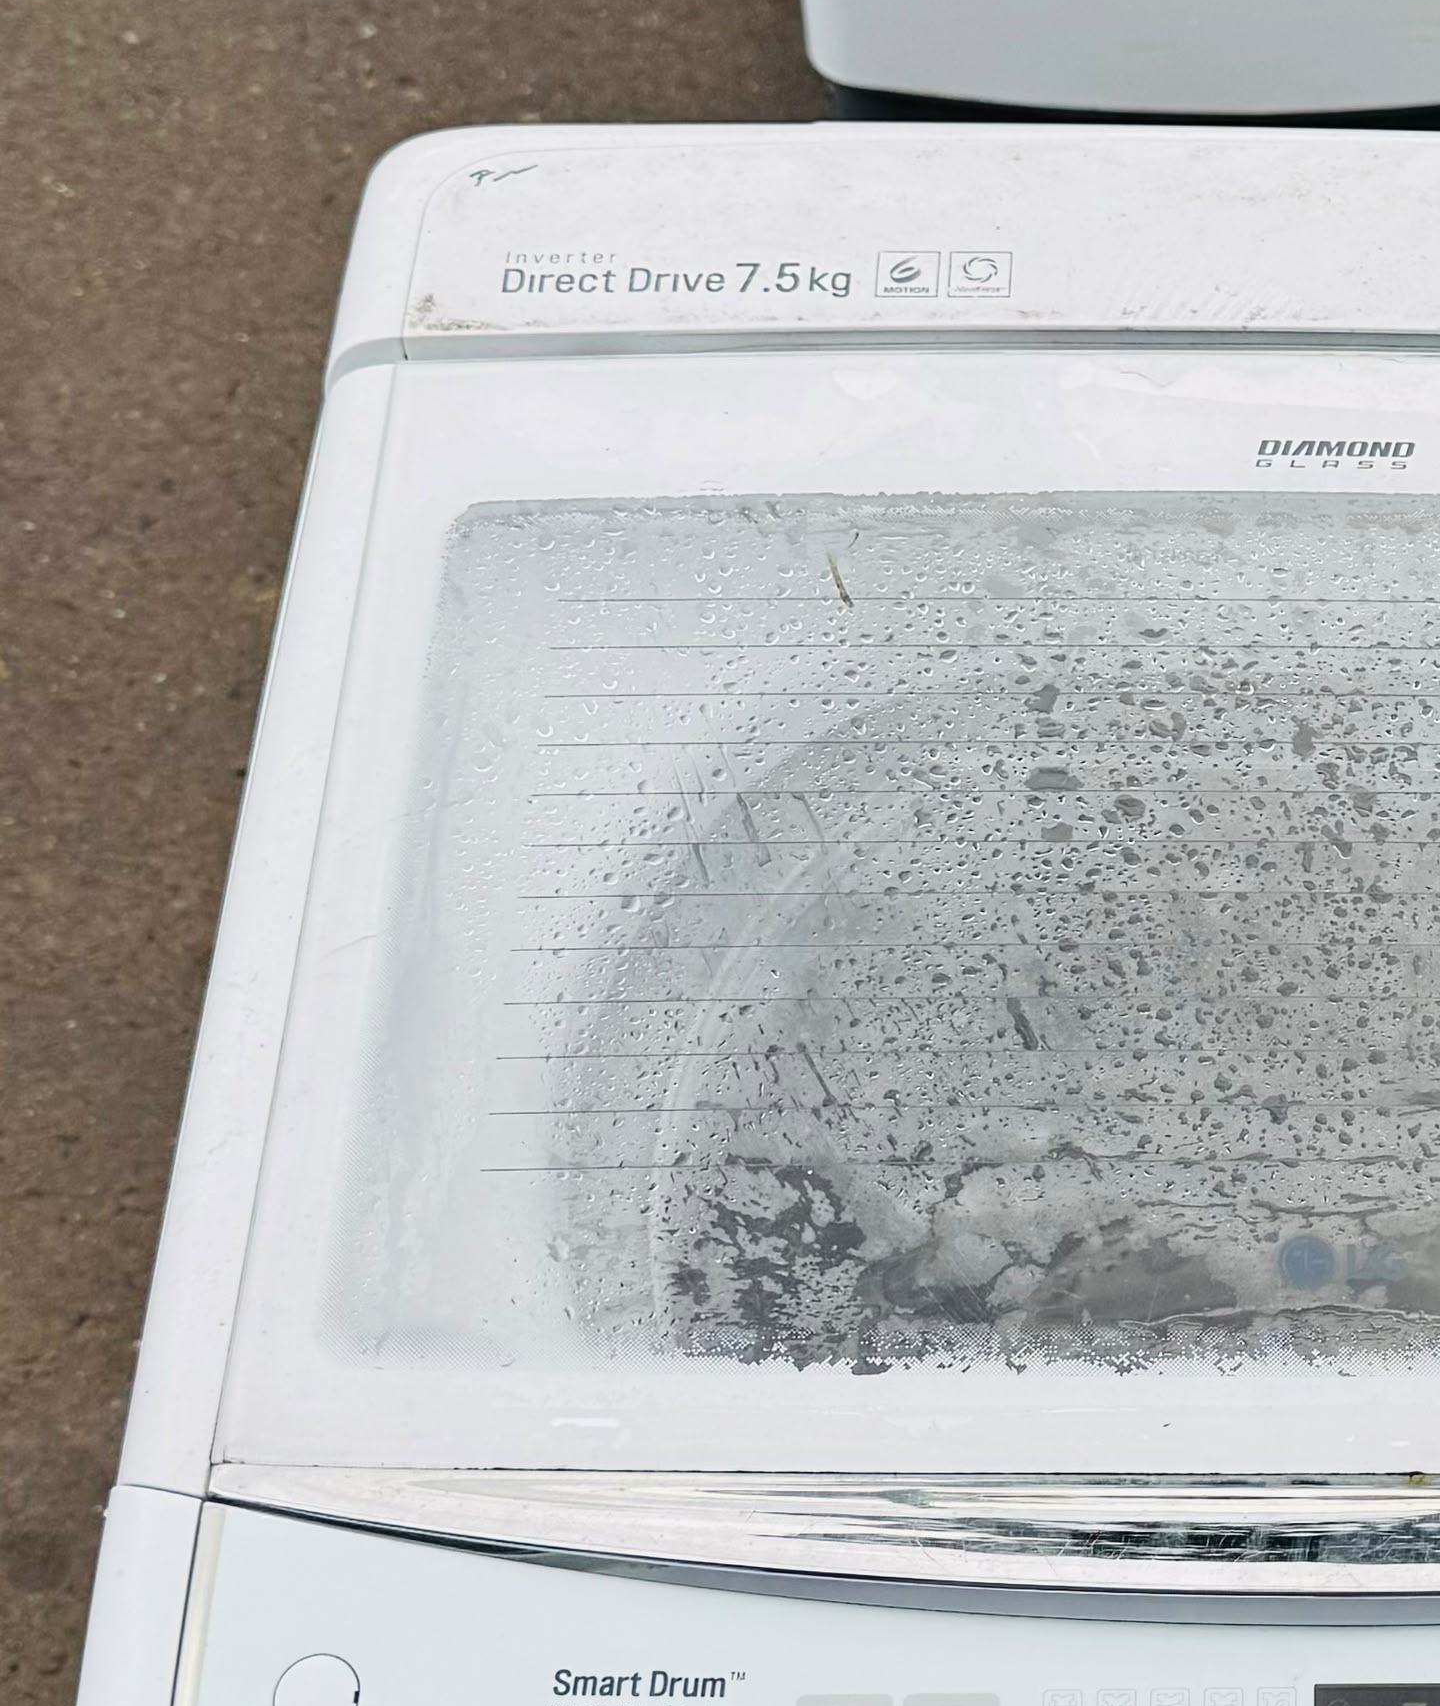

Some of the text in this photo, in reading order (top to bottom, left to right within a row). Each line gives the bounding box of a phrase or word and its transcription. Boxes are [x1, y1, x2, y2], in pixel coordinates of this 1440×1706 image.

[505, 250, 618, 266] Inverter
[501, 266, 616, 294] Direct
[628, 267, 726, 294] Drive
[883, 285, 930, 294] MOTION
[1257, 439, 1416, 458] DIAMOND
[1255, 459, 1408, 470] GLASS
[553, 1668, 643, 1697] Smart
